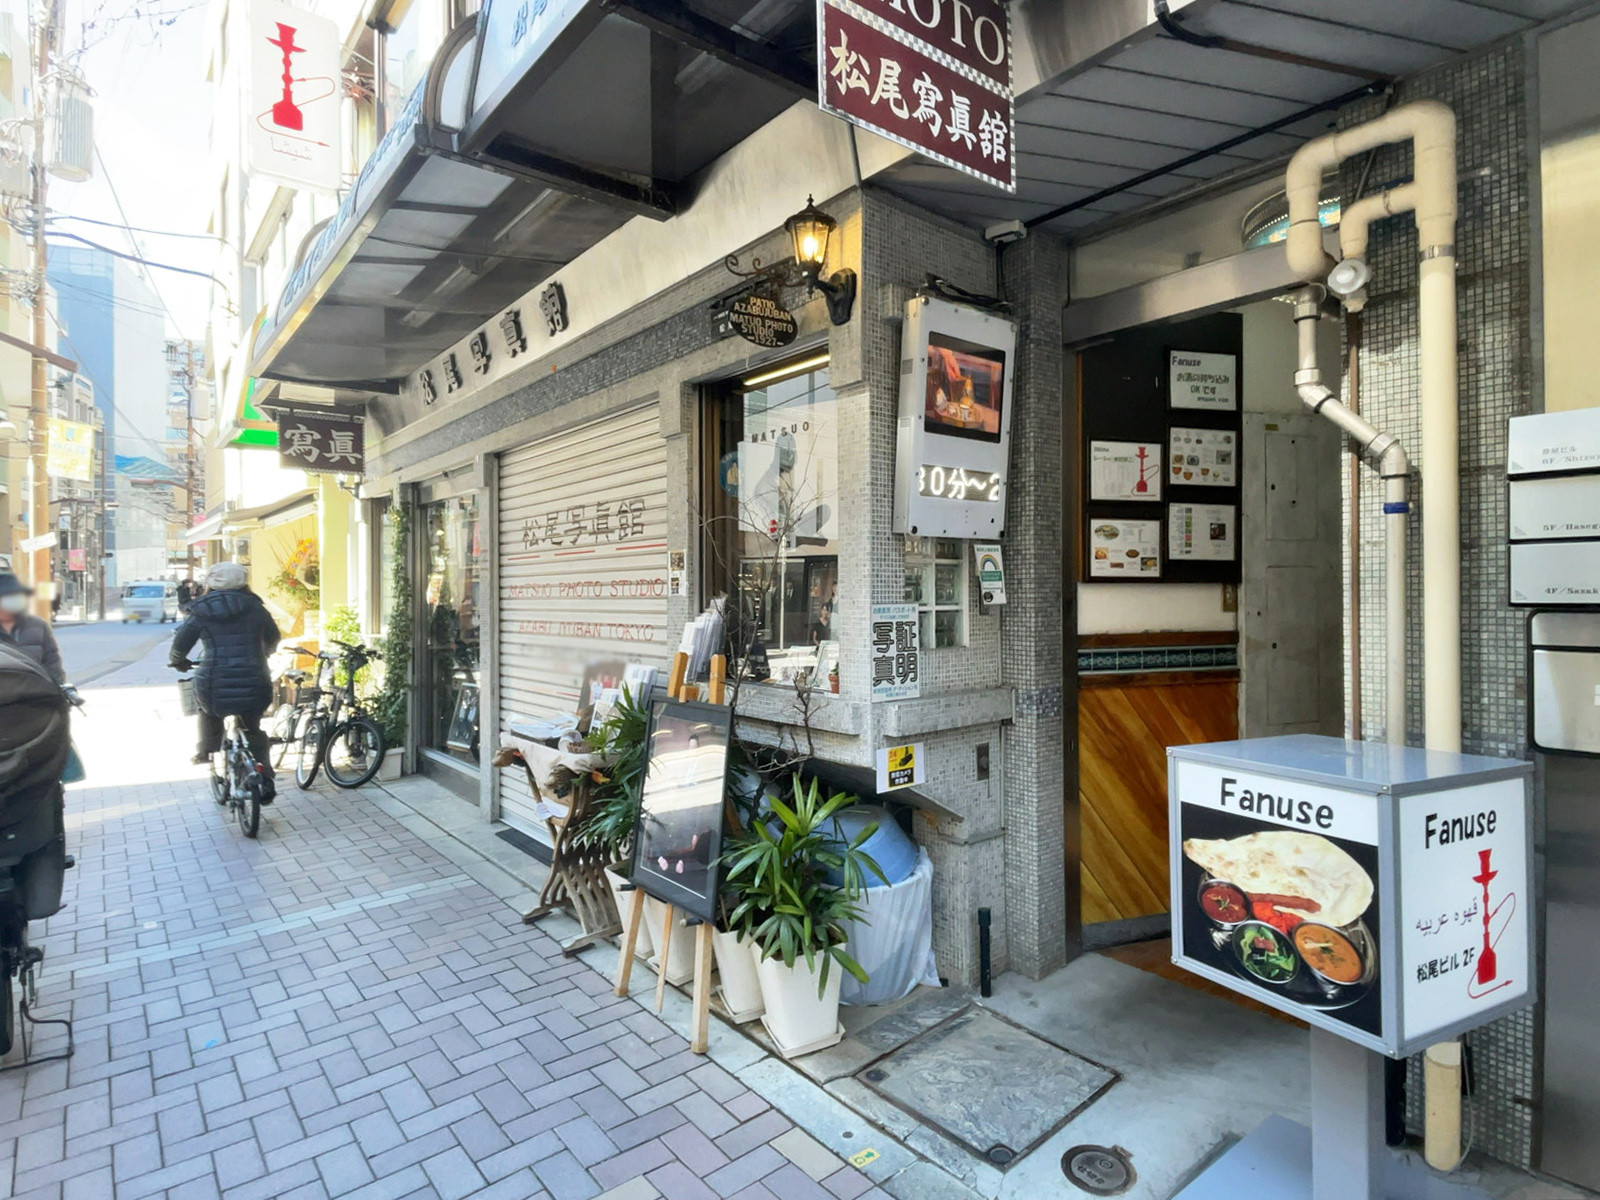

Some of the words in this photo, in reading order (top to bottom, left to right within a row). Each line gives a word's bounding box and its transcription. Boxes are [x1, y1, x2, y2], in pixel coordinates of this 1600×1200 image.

[879, 0, 1005, 66] OTO
[733, 302, 792, 322] AZABUJUBAN
[749, 296, 776, 310] PATIO
[729, 311, 762, 326] MATUO
[765, 319, 794, 334] PHOTO
[741, 323, 775, 338] STUDIO
[751, 421, 810, 444] MATSUO
[508, 582, 553, 598] MATSUO
[558, 580, 603, 598] PHOTO
[609, 577, 665, 598] STUDIO
[1220, 777, 1334, 830] Fanuse
[1424, 809, 1497, 850] Fanuse
[1416, 952, 1460, 984] 松尾ビル
[1462, 946, 1476, 967] 2F
